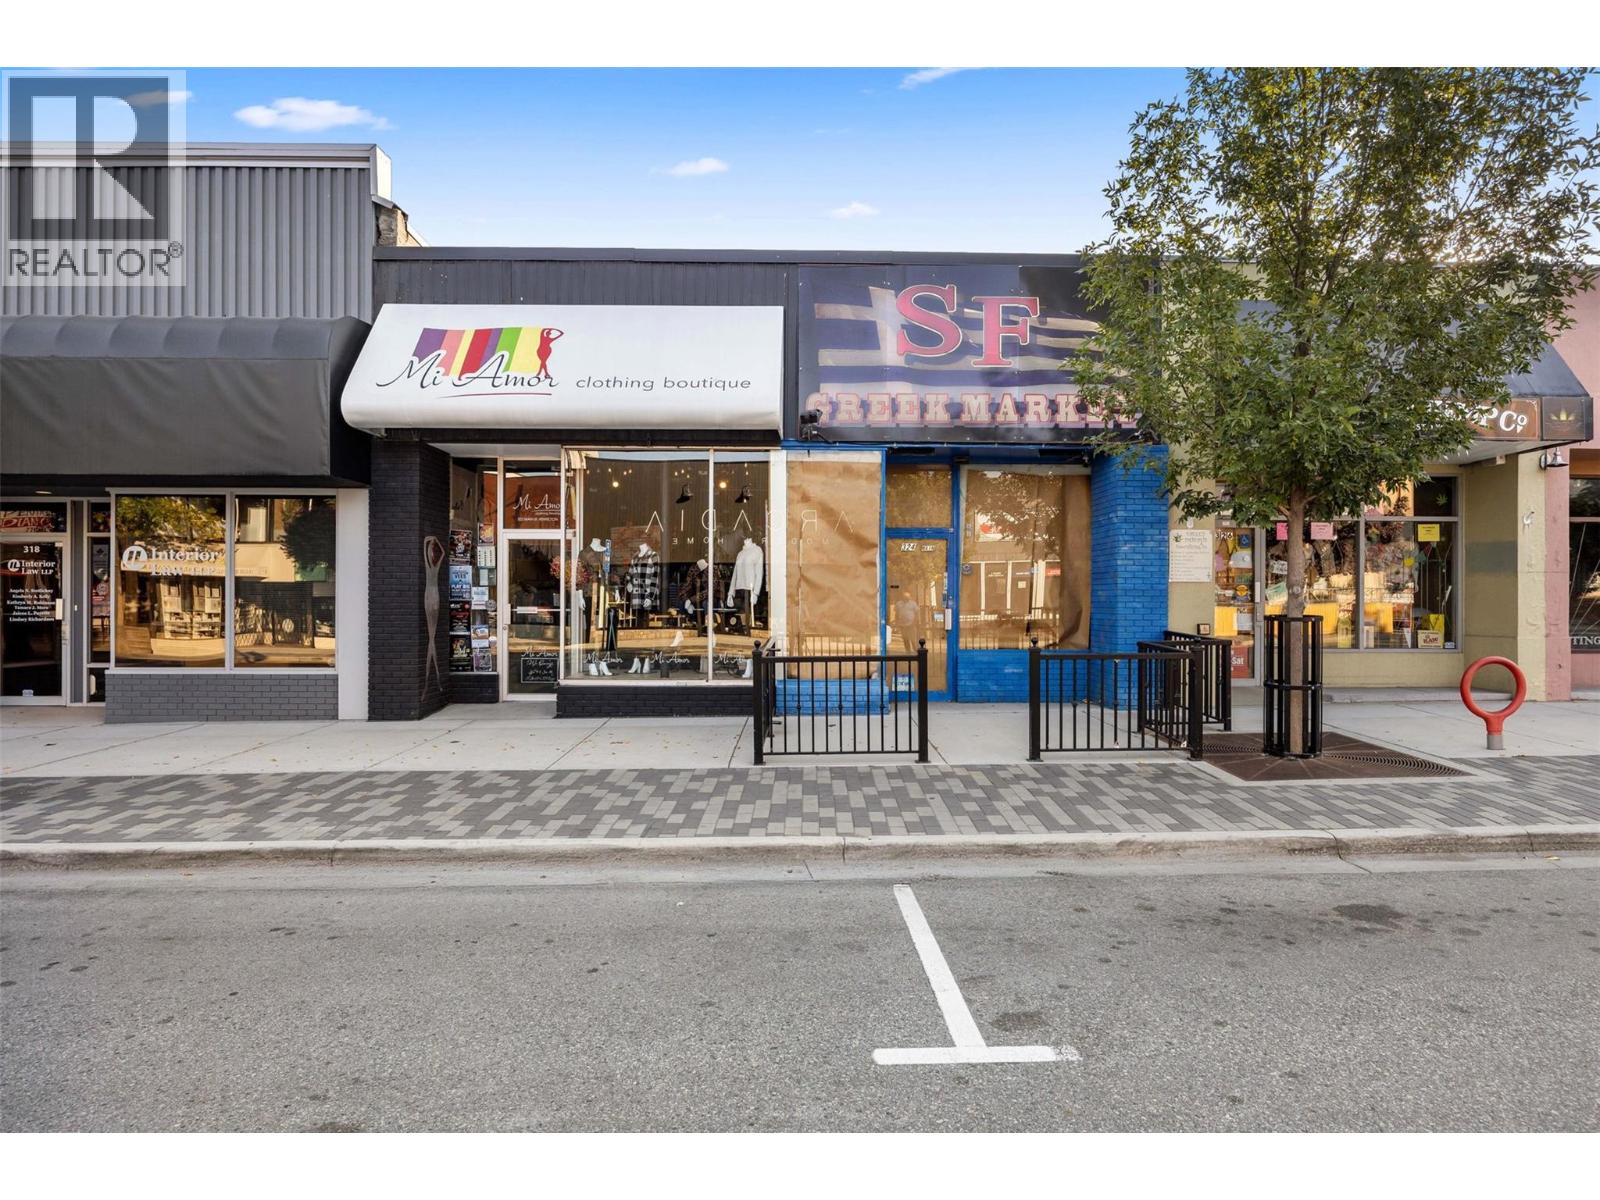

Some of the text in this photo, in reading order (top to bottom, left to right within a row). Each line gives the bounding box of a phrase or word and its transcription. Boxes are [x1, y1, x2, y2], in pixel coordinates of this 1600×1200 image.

[896, 284, 1040, 367] SF
[376, 352, 751, 391] Mi Amor clothing boutique
[805, 392, 951, 424] GREEK
[513, 493, 531, 510] Mi
[151, 547, 220, 561] Interior
[901, 543, 917, 551] 324
[21, 567, 40, 575] Law
